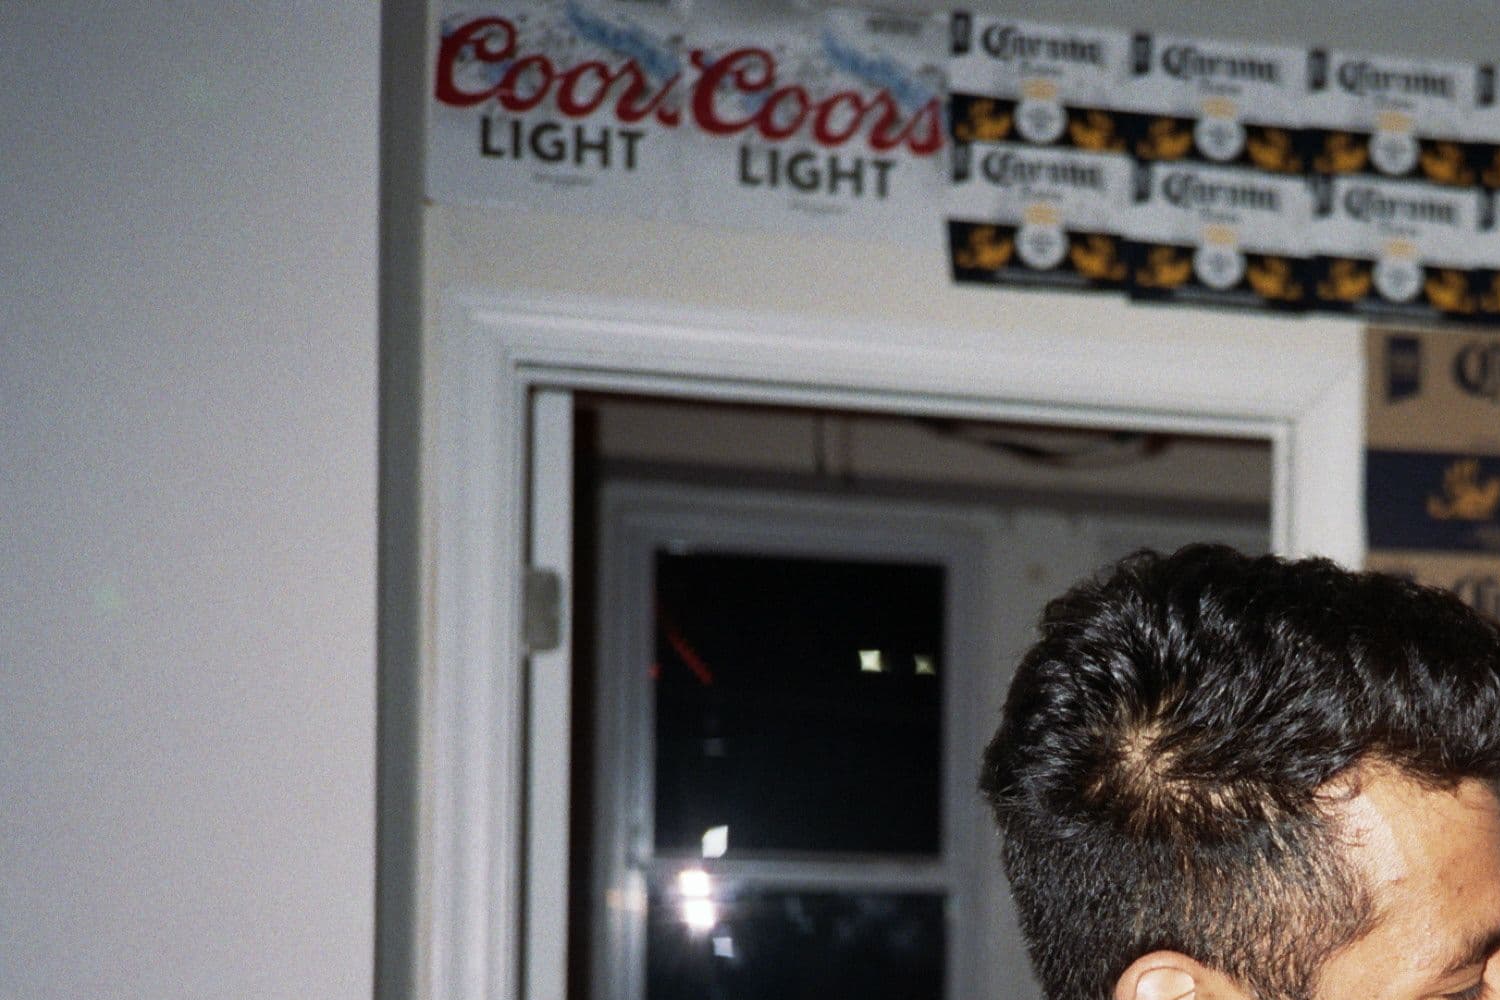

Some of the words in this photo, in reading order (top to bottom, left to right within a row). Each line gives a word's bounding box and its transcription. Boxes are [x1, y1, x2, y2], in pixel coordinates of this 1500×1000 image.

[688, 48, 944, 156] Coors
[479, 117, 645, 171] LIGHT
[737, 145, 897, 199] LIGHT
